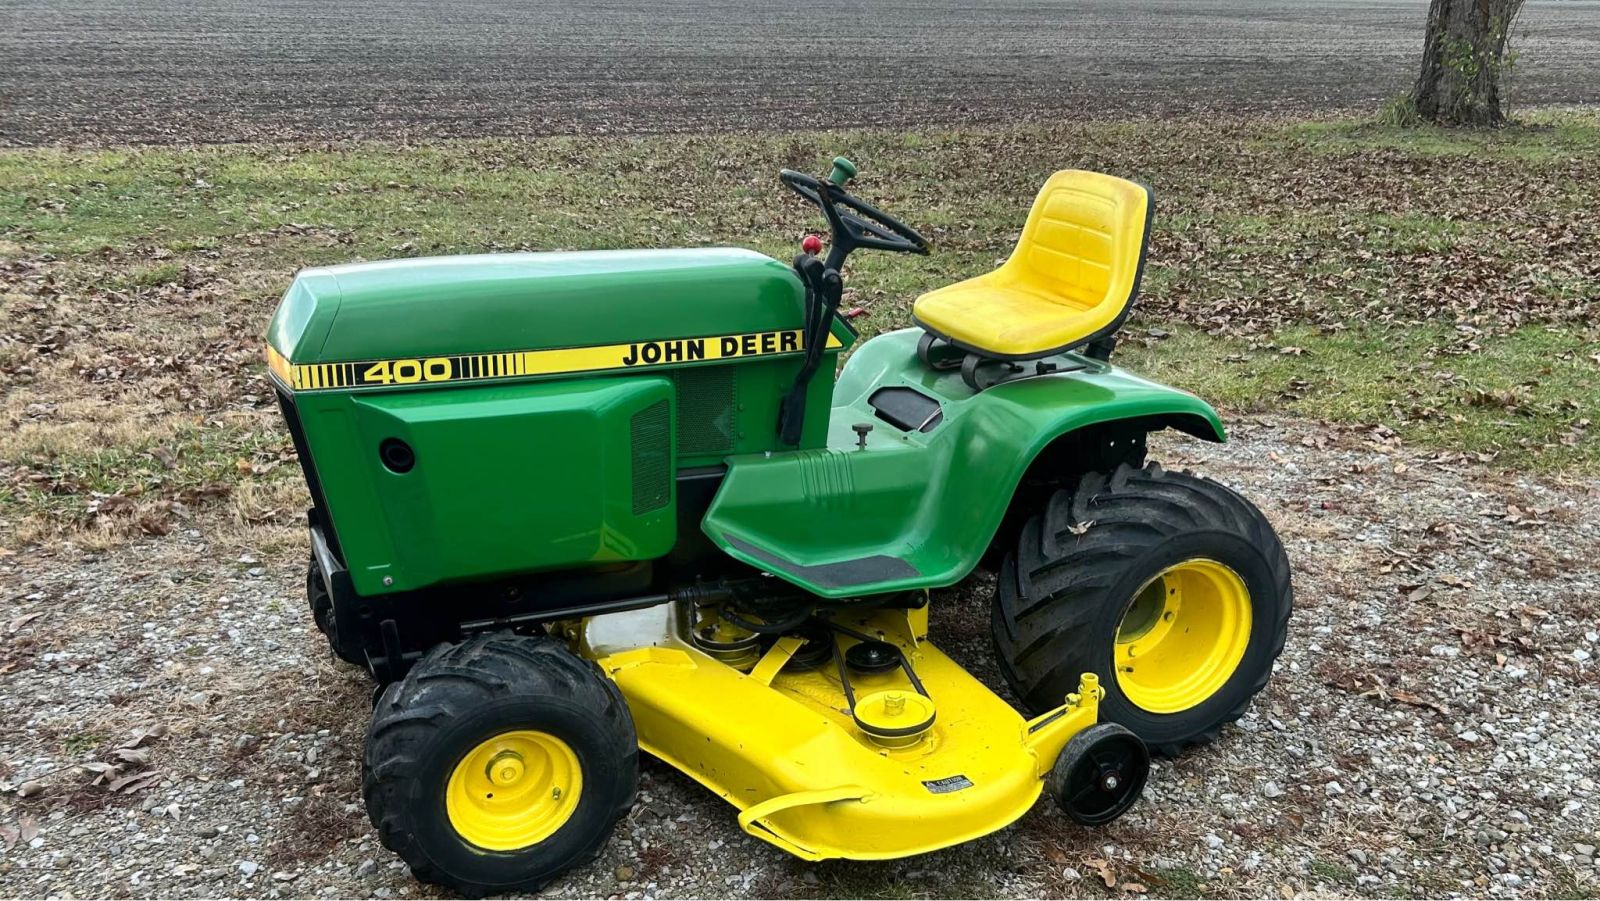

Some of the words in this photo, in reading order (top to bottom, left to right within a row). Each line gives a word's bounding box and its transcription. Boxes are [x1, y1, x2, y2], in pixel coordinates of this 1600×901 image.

[623, 339, 705, 366] JOHN
[720, 330, 806, 357] DEER
[364, 357, 452, 384] 400
